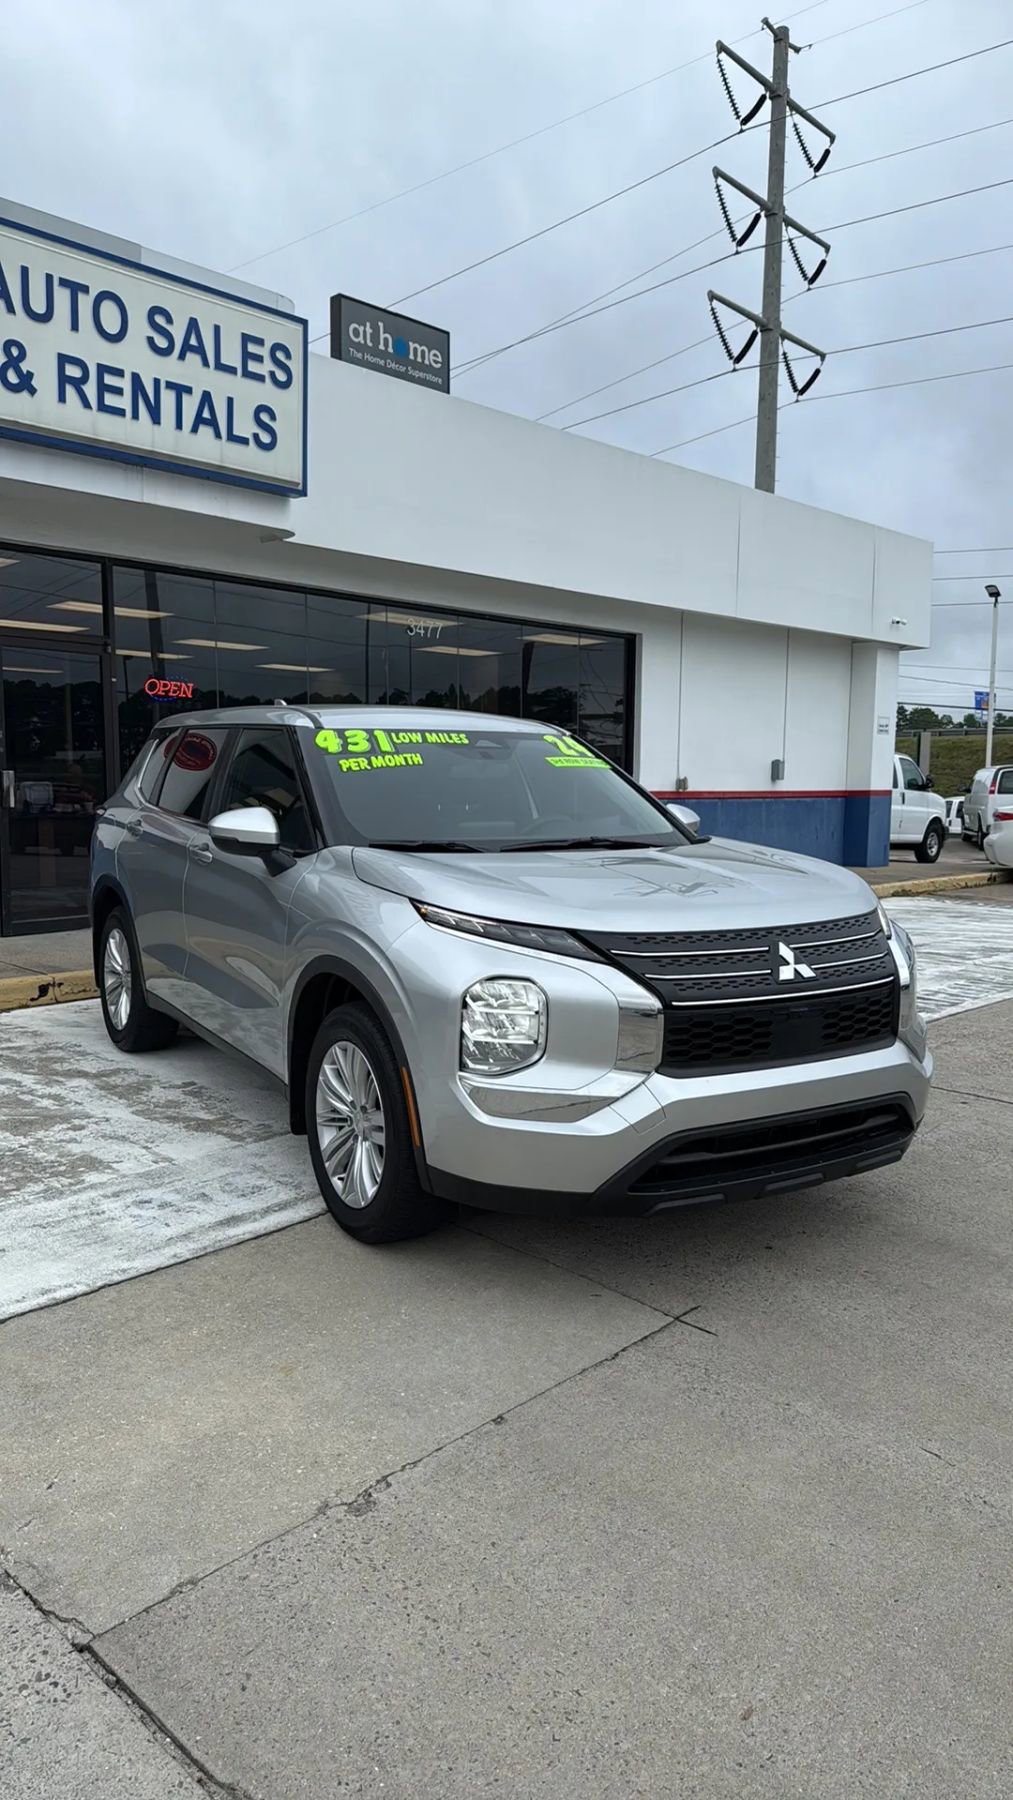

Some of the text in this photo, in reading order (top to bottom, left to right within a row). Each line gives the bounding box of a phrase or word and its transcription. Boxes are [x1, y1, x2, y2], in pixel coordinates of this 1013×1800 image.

[348, 321, 373, 347] at
[146, 306, 293, 389] SALES
[349, 347, 443, 385] The Home Décor Superstore
[0, 338, 278, 451] & RENTALS
[407, 617, 443, 639] 3477
[144, 678, 194, 699] OPEN
[315, 729, 396, 753] 431
[391, 732, 469, 745] LOW MILES
[338, 753, 424, 773] PER MONTH
